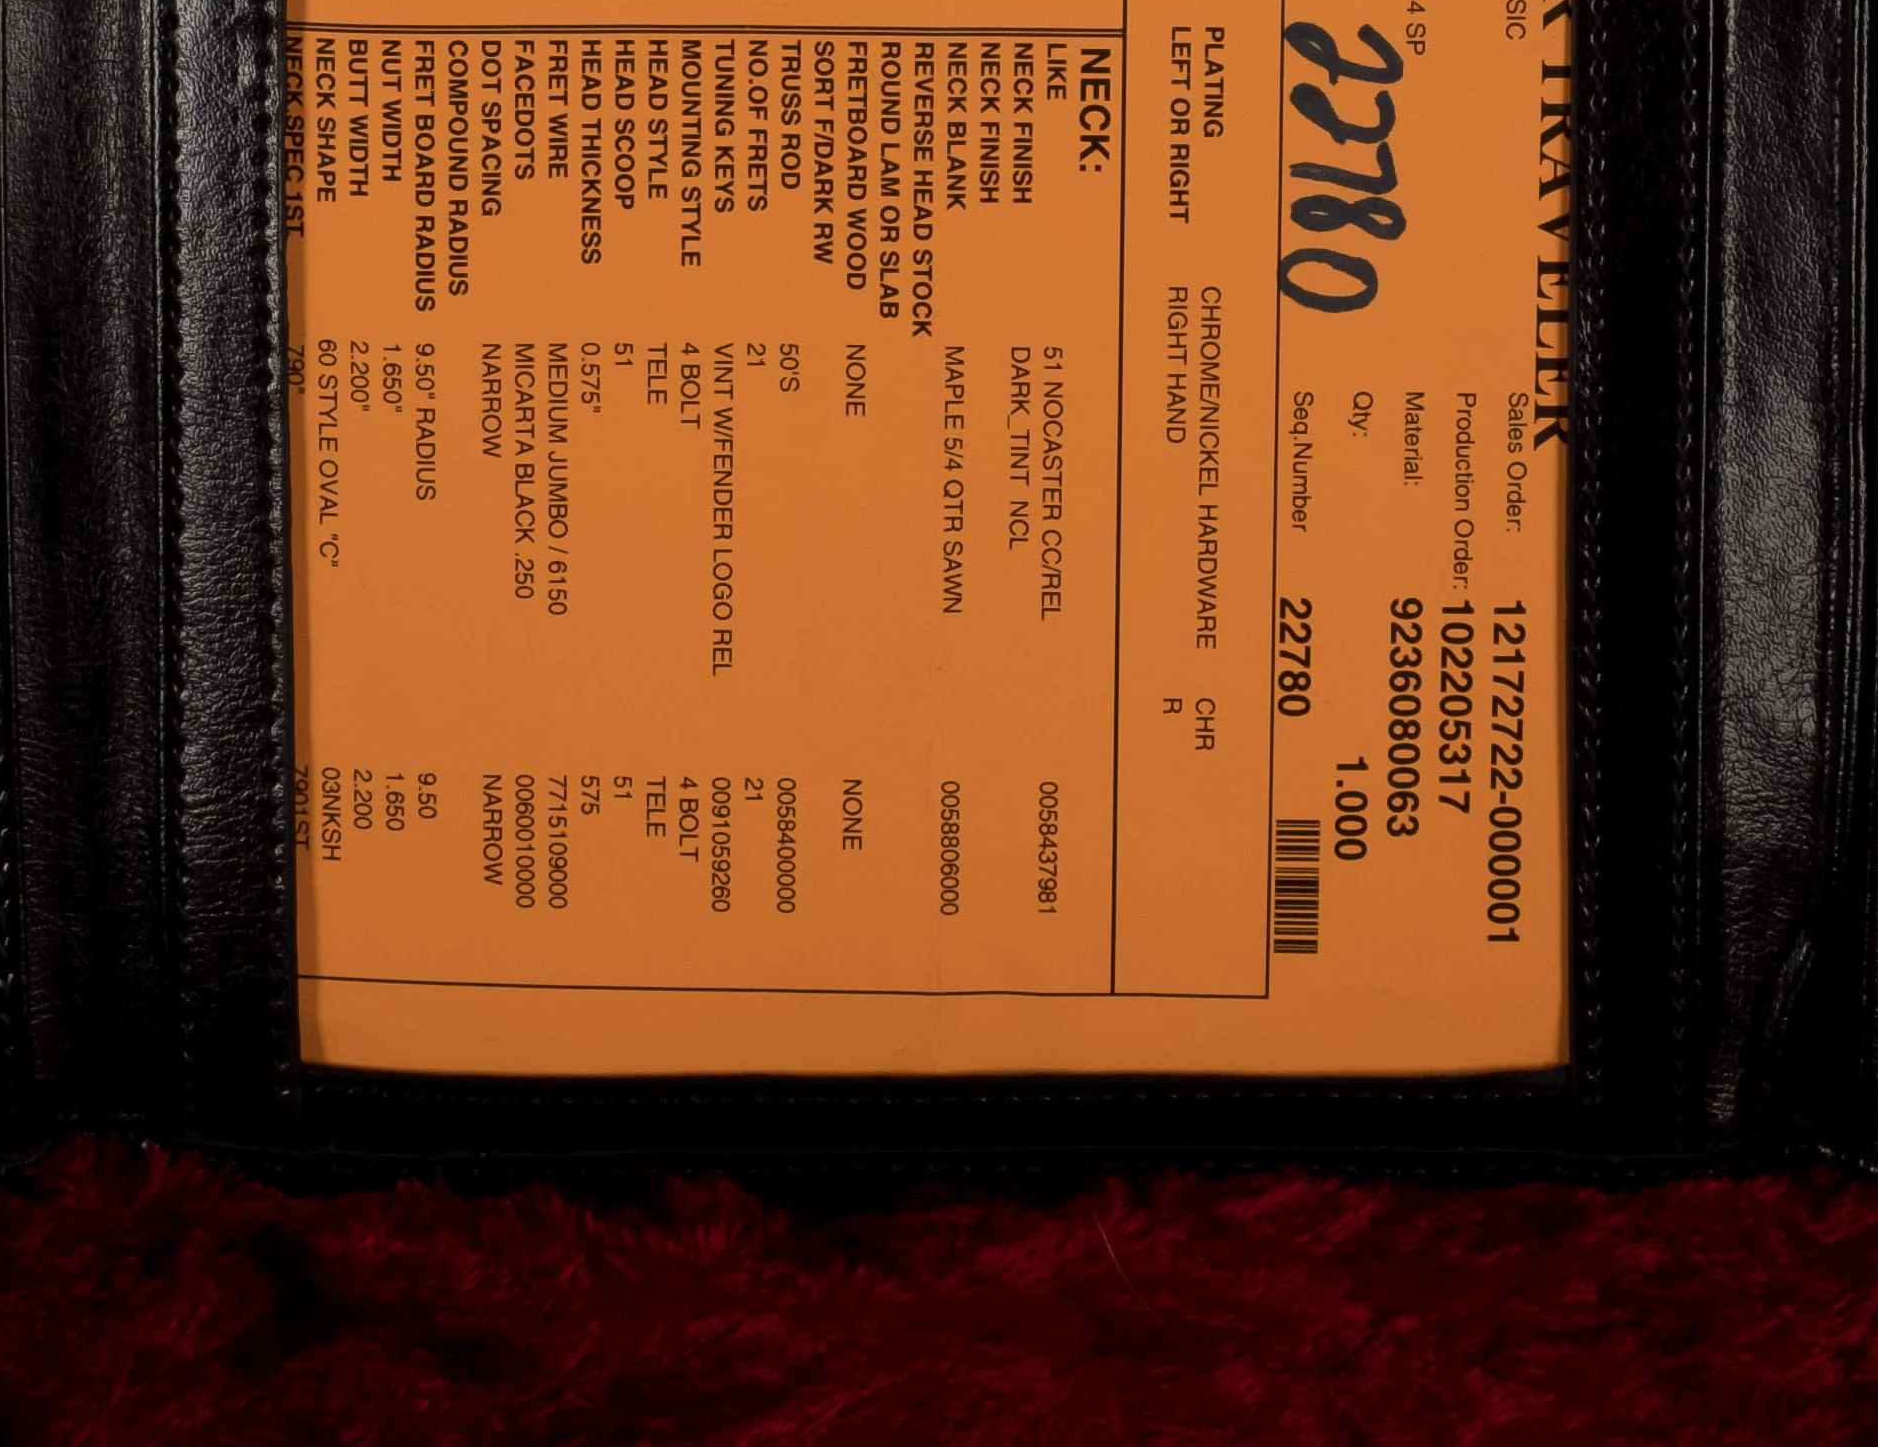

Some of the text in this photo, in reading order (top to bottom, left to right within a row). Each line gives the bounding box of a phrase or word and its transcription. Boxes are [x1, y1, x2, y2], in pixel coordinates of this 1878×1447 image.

[581, 40, 602, 264] HEAD THICKNESS
[1079, 48, 1111, 172] NECK:
[1278, 20, 1407, 314] 22780
[1038, 43, 1067, 913] LIKE 51 NOCASTER CC/REL 0058437981
[1197, 27, 1225, 649] PLATING CHROME/NICKEL HARDWARE
[1277, 392, 1314, 717] Seq.Number 22780
[1438, 393, 1477, 814] Production Order: 102205317
[1487, 393, 1529, 942] Sales Order: 12172722-000001
[548, 775, 568, 909] 7715109000
